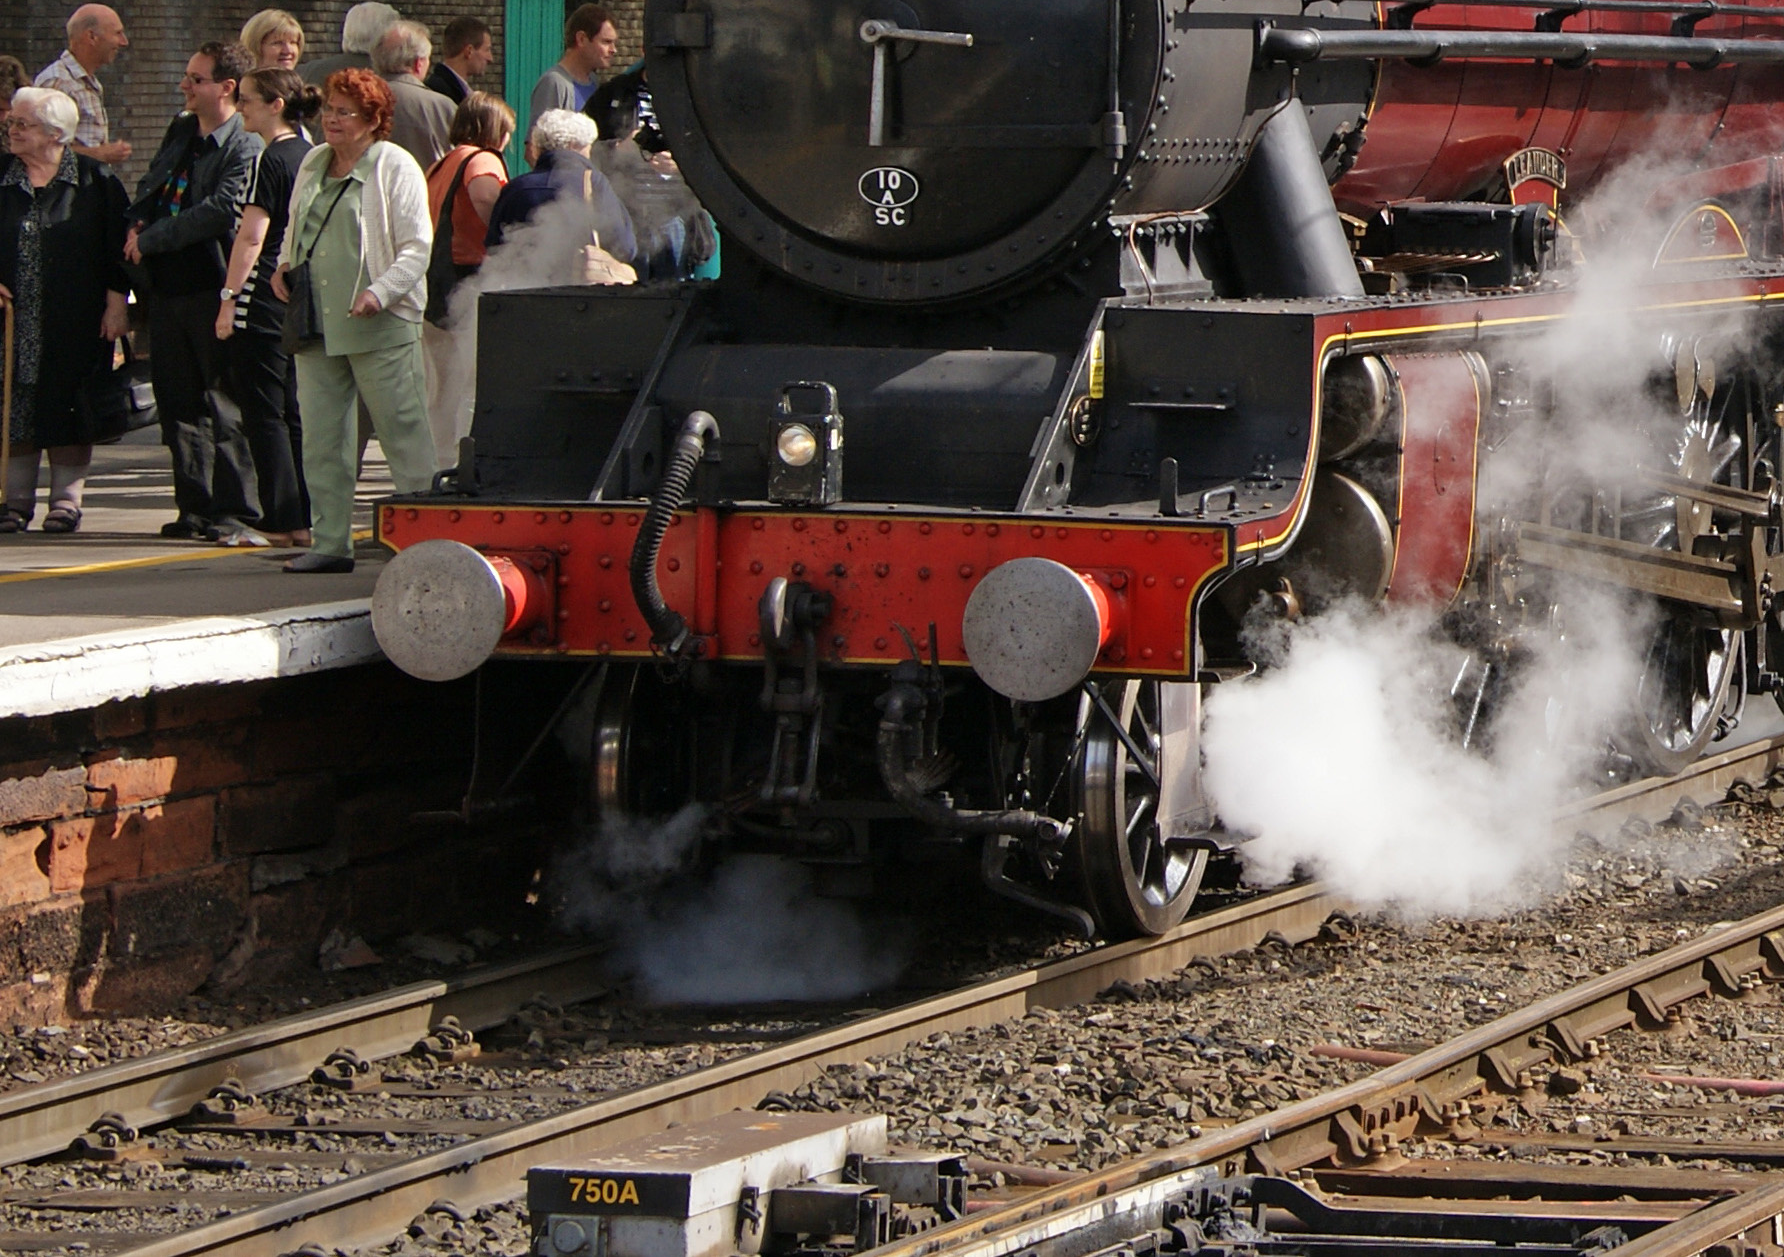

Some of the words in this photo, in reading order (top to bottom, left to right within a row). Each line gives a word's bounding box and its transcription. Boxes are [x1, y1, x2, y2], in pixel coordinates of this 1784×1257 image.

[1513, 151, 1559, 181] LEANDER
[879, 170, 901, 190] 10
[881, 190, 895, 204] A
[875, 207, 905, 226] SC
[569, 1177, 640, 1205] 750A
